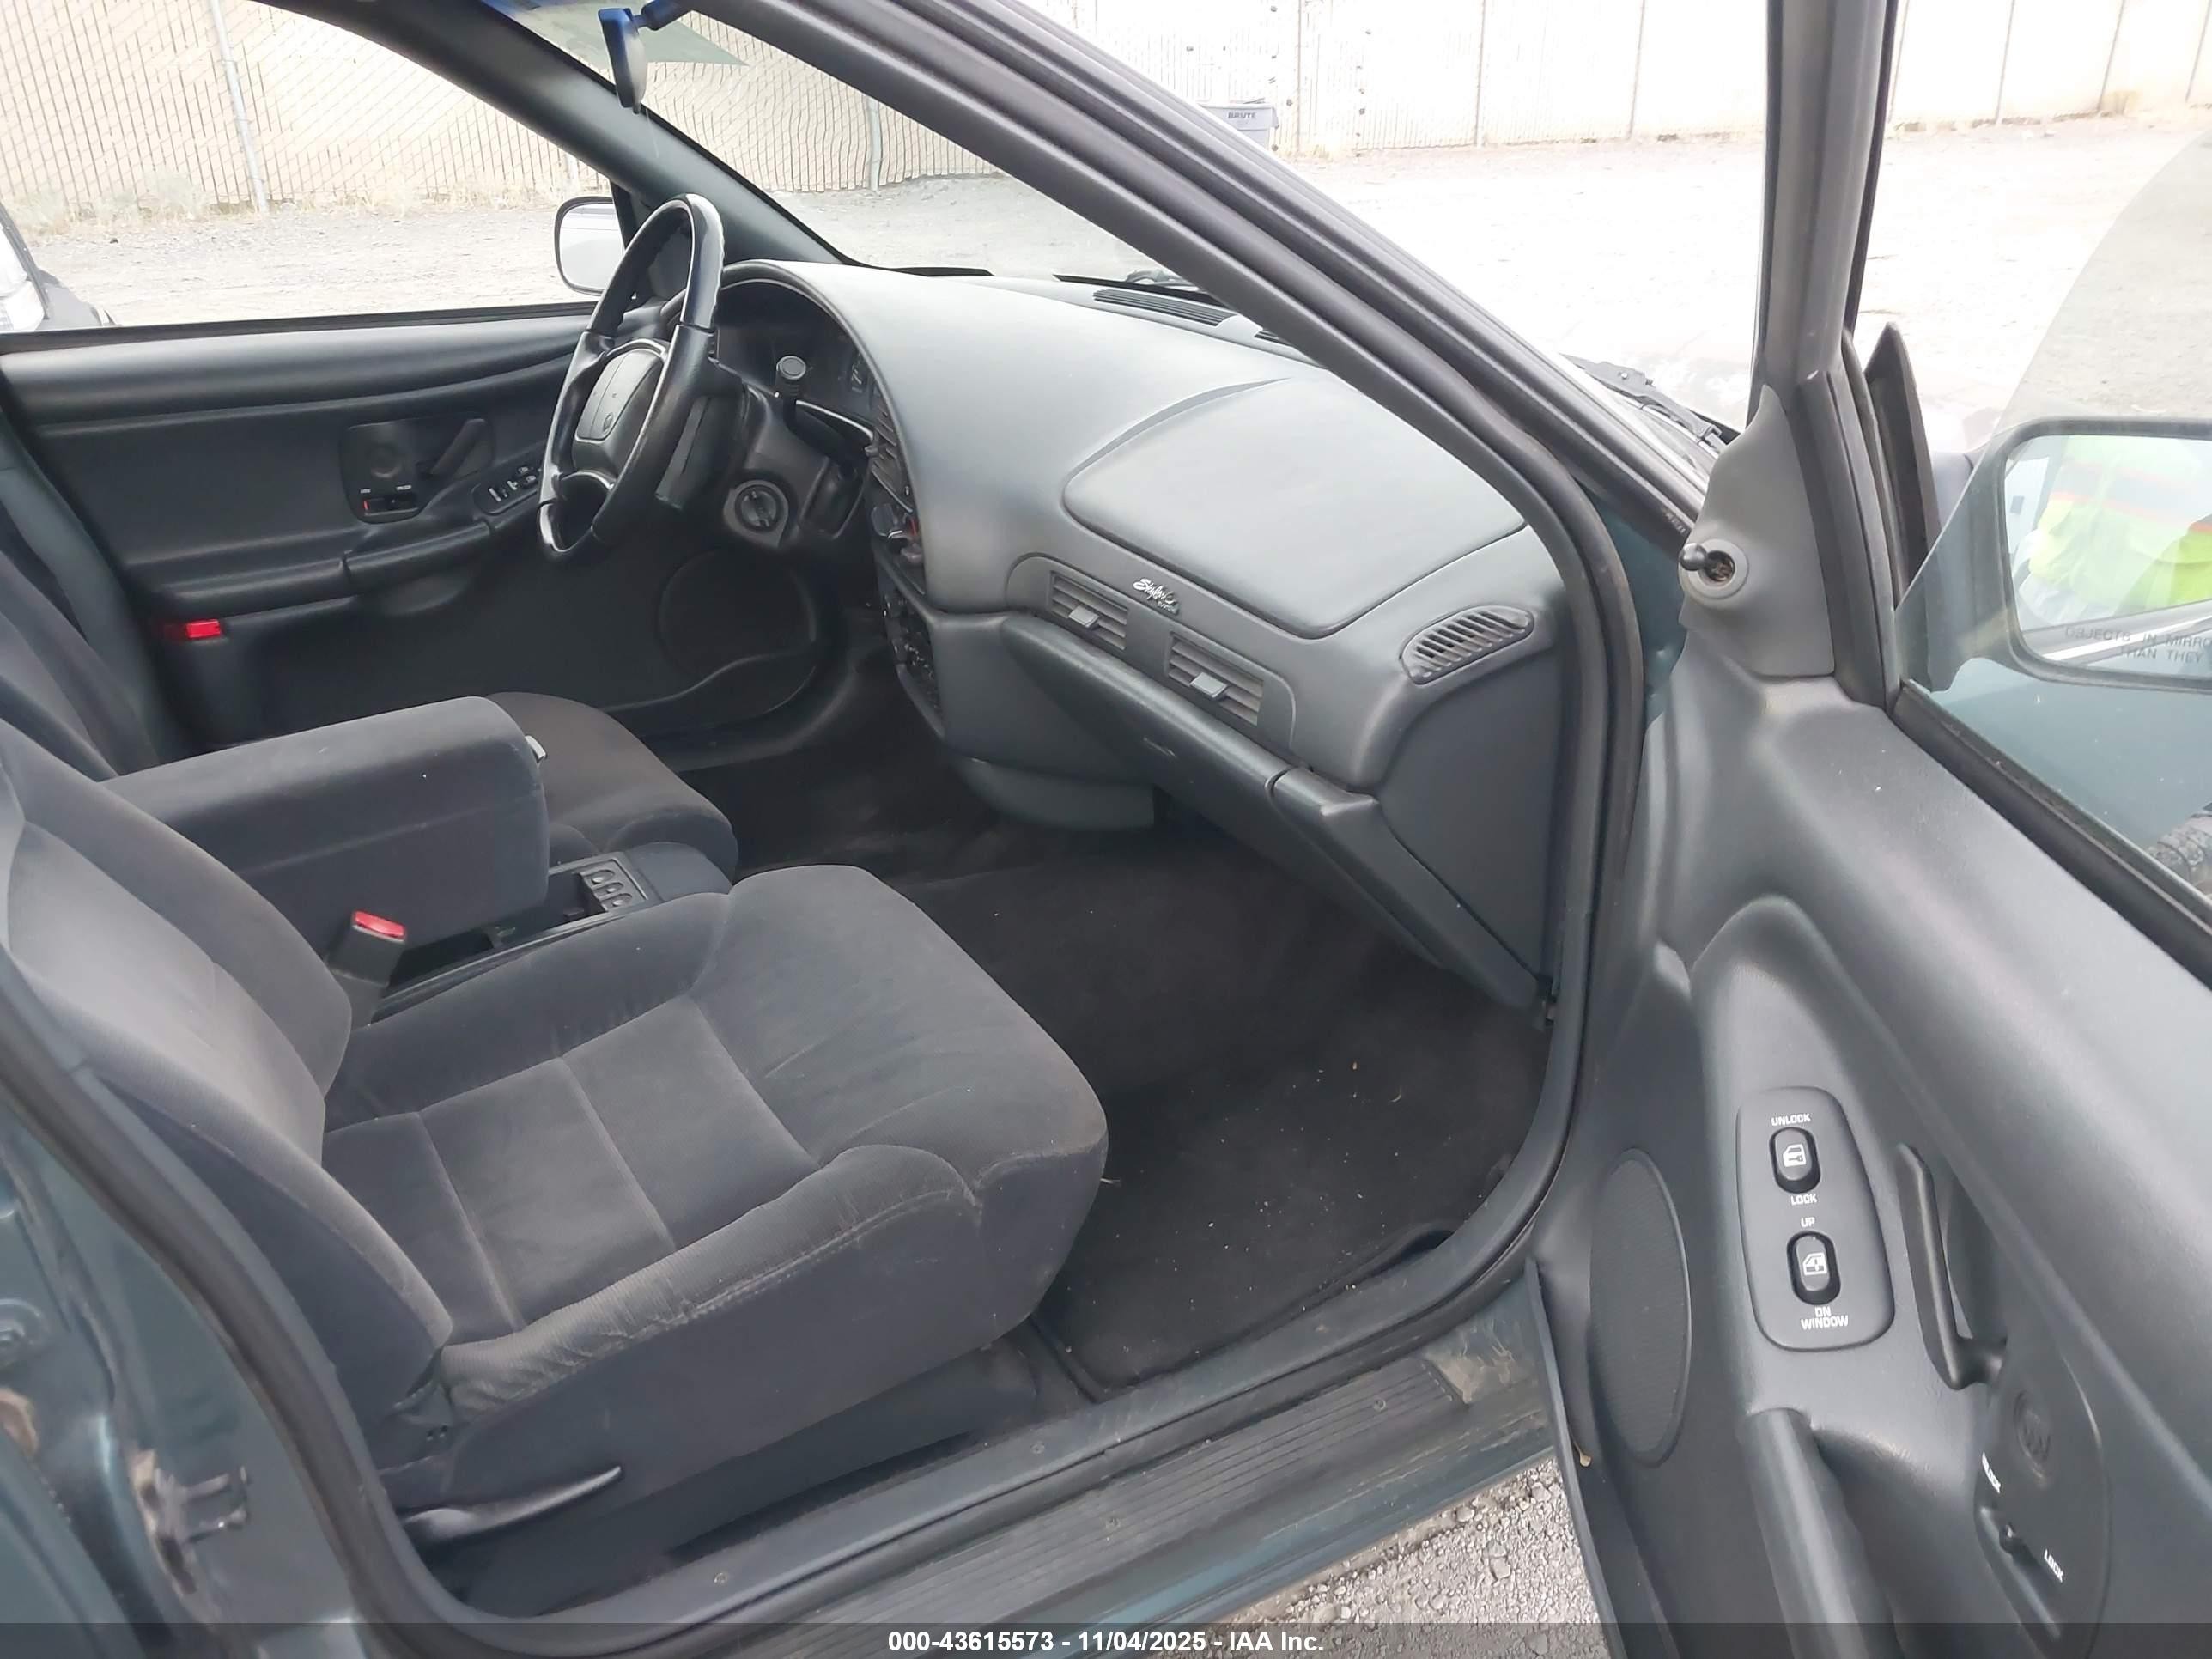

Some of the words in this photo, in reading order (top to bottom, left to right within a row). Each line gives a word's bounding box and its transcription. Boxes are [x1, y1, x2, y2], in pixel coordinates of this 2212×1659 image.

[2165, 634, 2212, 647] MIRRO
[1771, 1114, 1811, 1127] UNLOCK
[1790, 1194, 1818, 1205] LOCK
[1801, 1218, 1815, 1228] UP
[1801, 1315, 1849, 1330] WINDOW
[2044, 1549, 2063, 1583] LOCK
